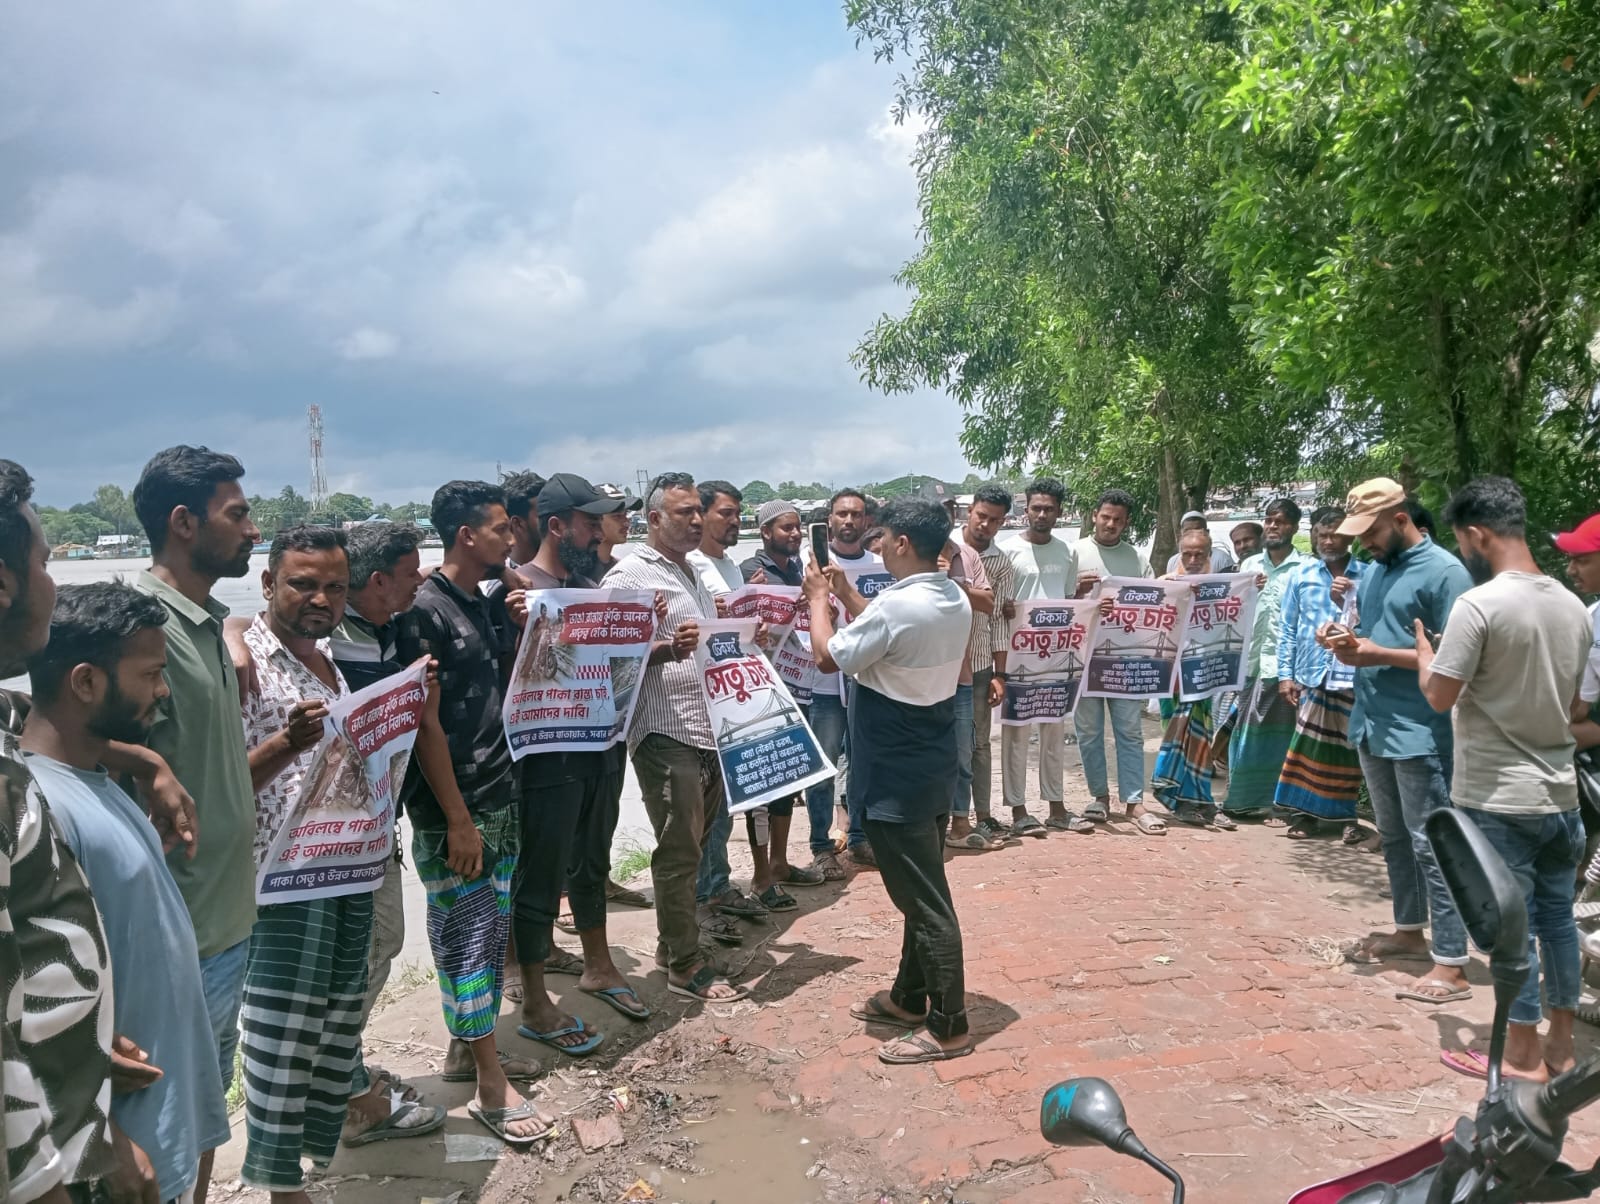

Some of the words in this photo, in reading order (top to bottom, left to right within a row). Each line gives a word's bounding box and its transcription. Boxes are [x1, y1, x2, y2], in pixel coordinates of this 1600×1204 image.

[1124, 590, 1159, 603] টেকসই
[1200, 585, 1226, 597] টকসই
[603, 607, 621, 625] ঝুঁকি
[623, 611, 651, 624] অনেক,
[1035, 610, 1068, 624] টেকসই
[1101, 607, 1140, 632] সতু
[1143, 604, 1178, 631] চাই
[1190, 604, 1213, 630] তু
[1214, 596, 1242, 622] চাই
[591, 627, 608, 638] হোক
[610, 624, 642, 639] নিরাপদ;
[1011, 631, 1052, 658] সেতু
[1057, 623, 1086, 649] চাই
[705, 662, 752, 703] সেতু
[742, 653, 776, 687] চাই
[512, 689, 543, 705] অবিলম্বে
[546, 687, 571, 701] পাকা
[573, 687, 593, 700] রাস্তা
[509, 710, 521, 724] এই
[522, 707, 560, 721] আমাদের
[563, 704, 590, 719] দাবি।
[538, 730, 554, 740] উন্নত
[288, 820, 345, 841] অবিলম্বে
[348, 819, 377, 833] পাকা
[279, 844, 300, 862] এই
[303, 841, 364, 858] আমাদের
[270, 875, 294, 888] পাকা
[296, 873, 316, 888] সেতু
[317, 872, 325, 882] ও
[327, 868, 350, 881] উন্নত
